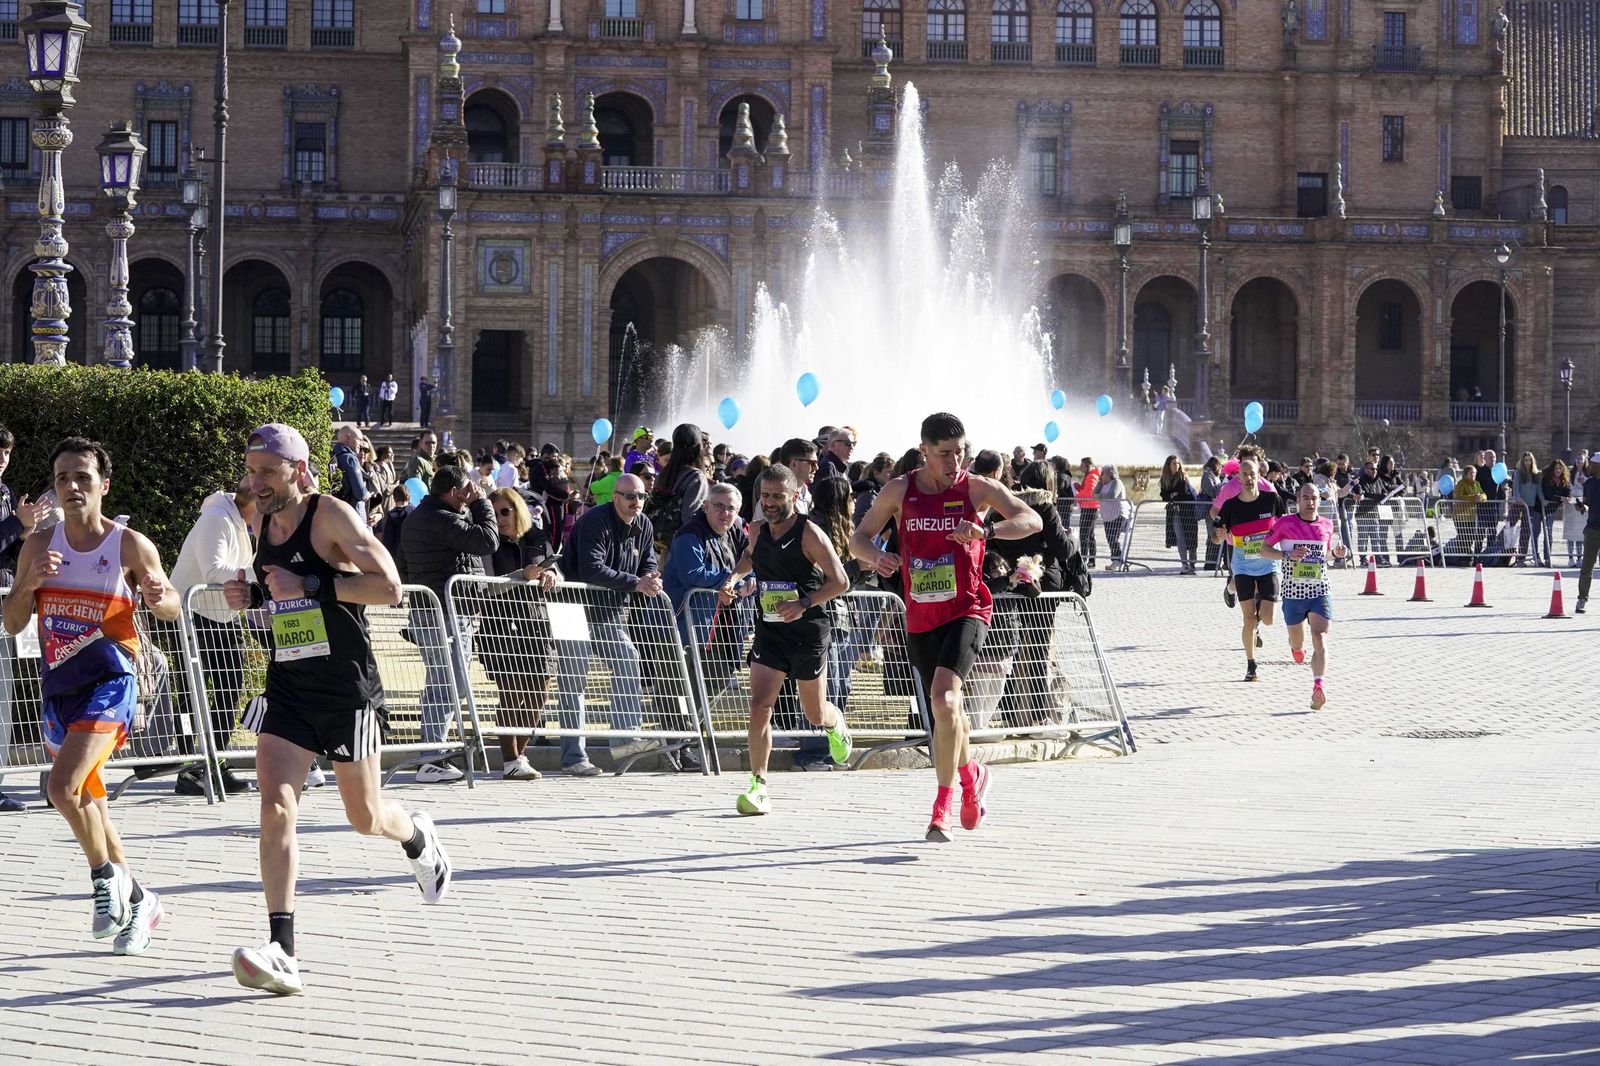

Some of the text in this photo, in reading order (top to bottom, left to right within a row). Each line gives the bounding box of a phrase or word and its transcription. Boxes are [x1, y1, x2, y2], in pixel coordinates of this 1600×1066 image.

[279, 599, 312, 610] ZURICH
[283, 619, 300, 628] 1683
[54, 634, 87, 660] CHEMA
